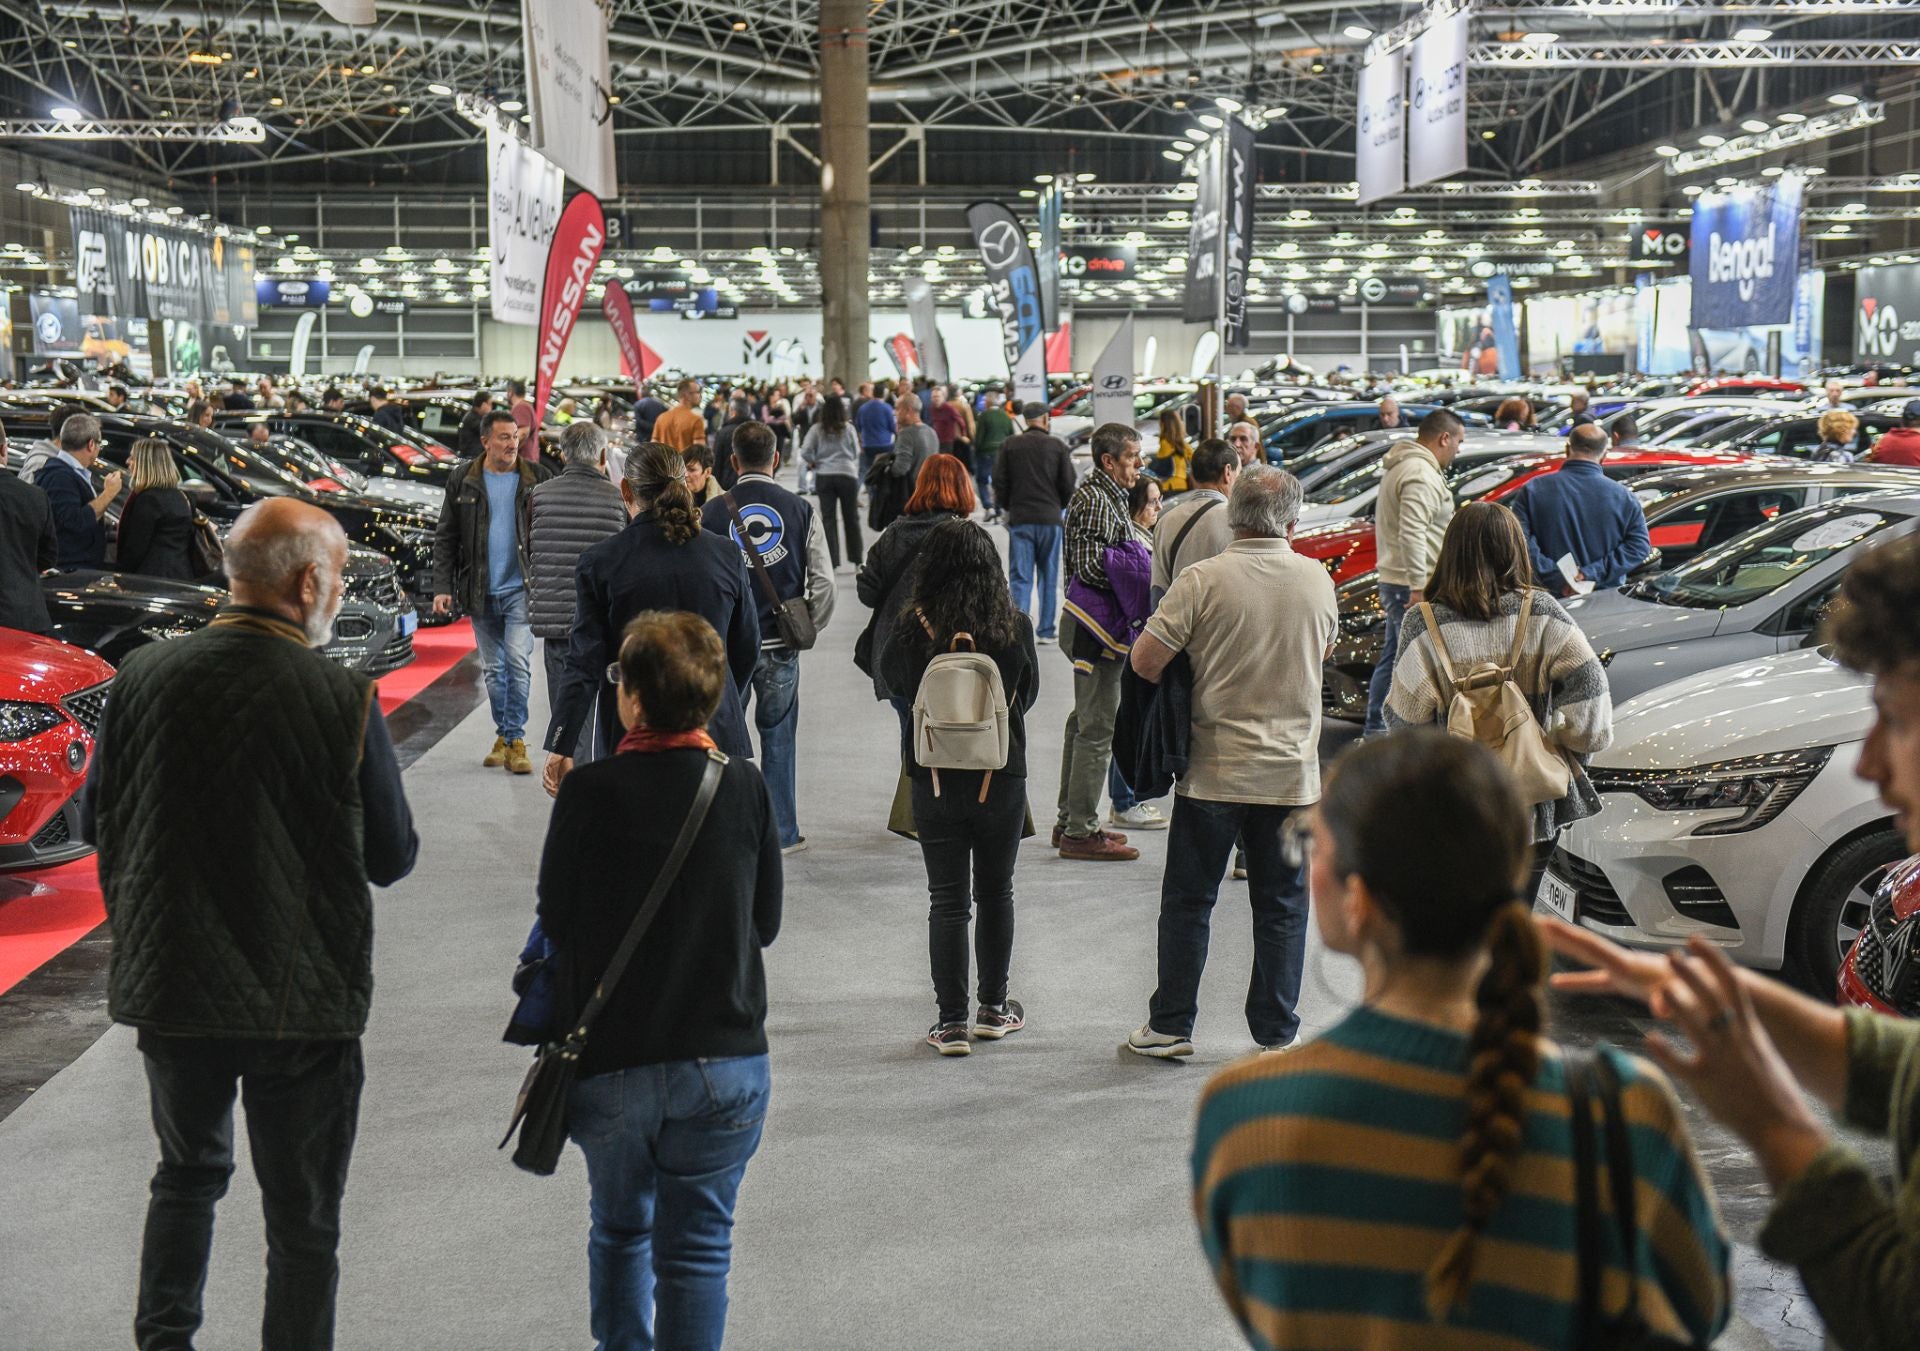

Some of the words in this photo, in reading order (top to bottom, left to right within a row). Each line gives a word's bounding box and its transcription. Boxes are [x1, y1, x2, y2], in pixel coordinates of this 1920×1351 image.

[607, 218, 620, 238] B
[1088, 257, 1126, 272] drive
[539, 223, 603, 377] NISSAN
[763, 547, 785, 564] CORP.
